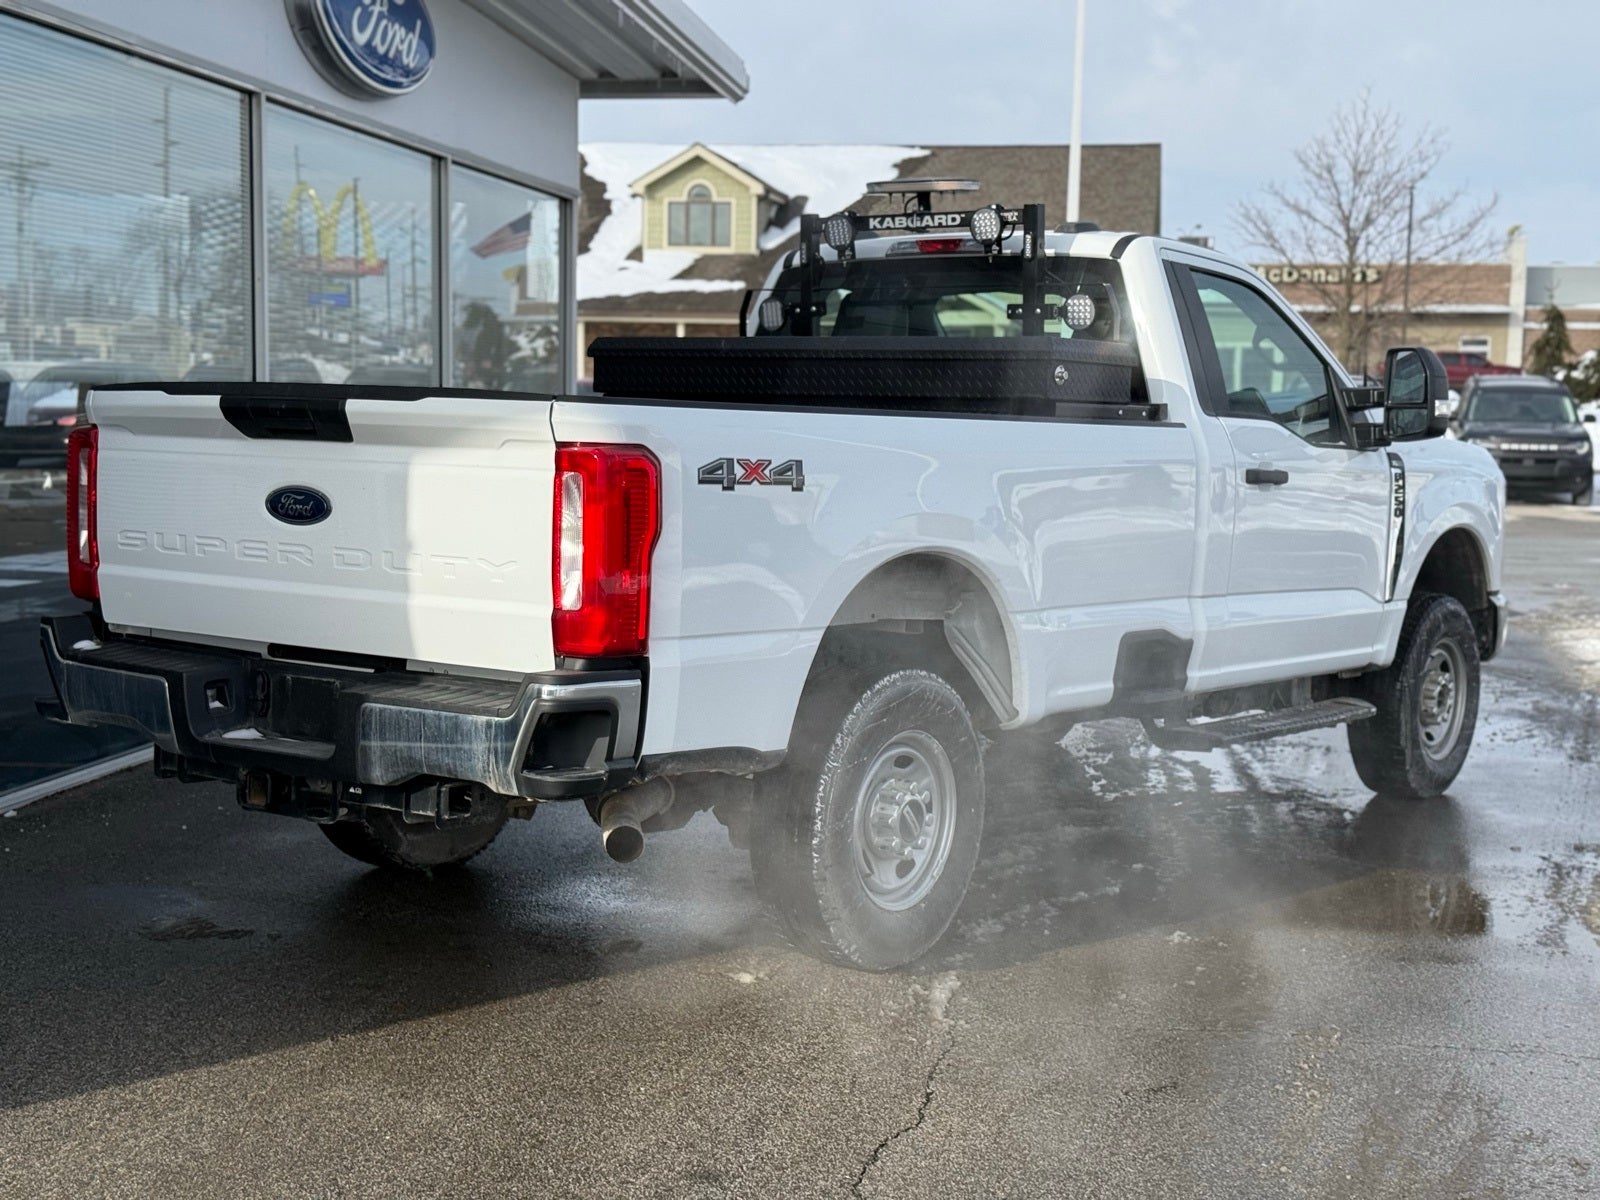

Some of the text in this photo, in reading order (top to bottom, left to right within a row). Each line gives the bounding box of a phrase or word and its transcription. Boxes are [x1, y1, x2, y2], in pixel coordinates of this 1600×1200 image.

[351, 0, 421, 69] Ford
[278, 493, 314, 516] Ford
[117, 529, 518, 583] SUPER DUTY
